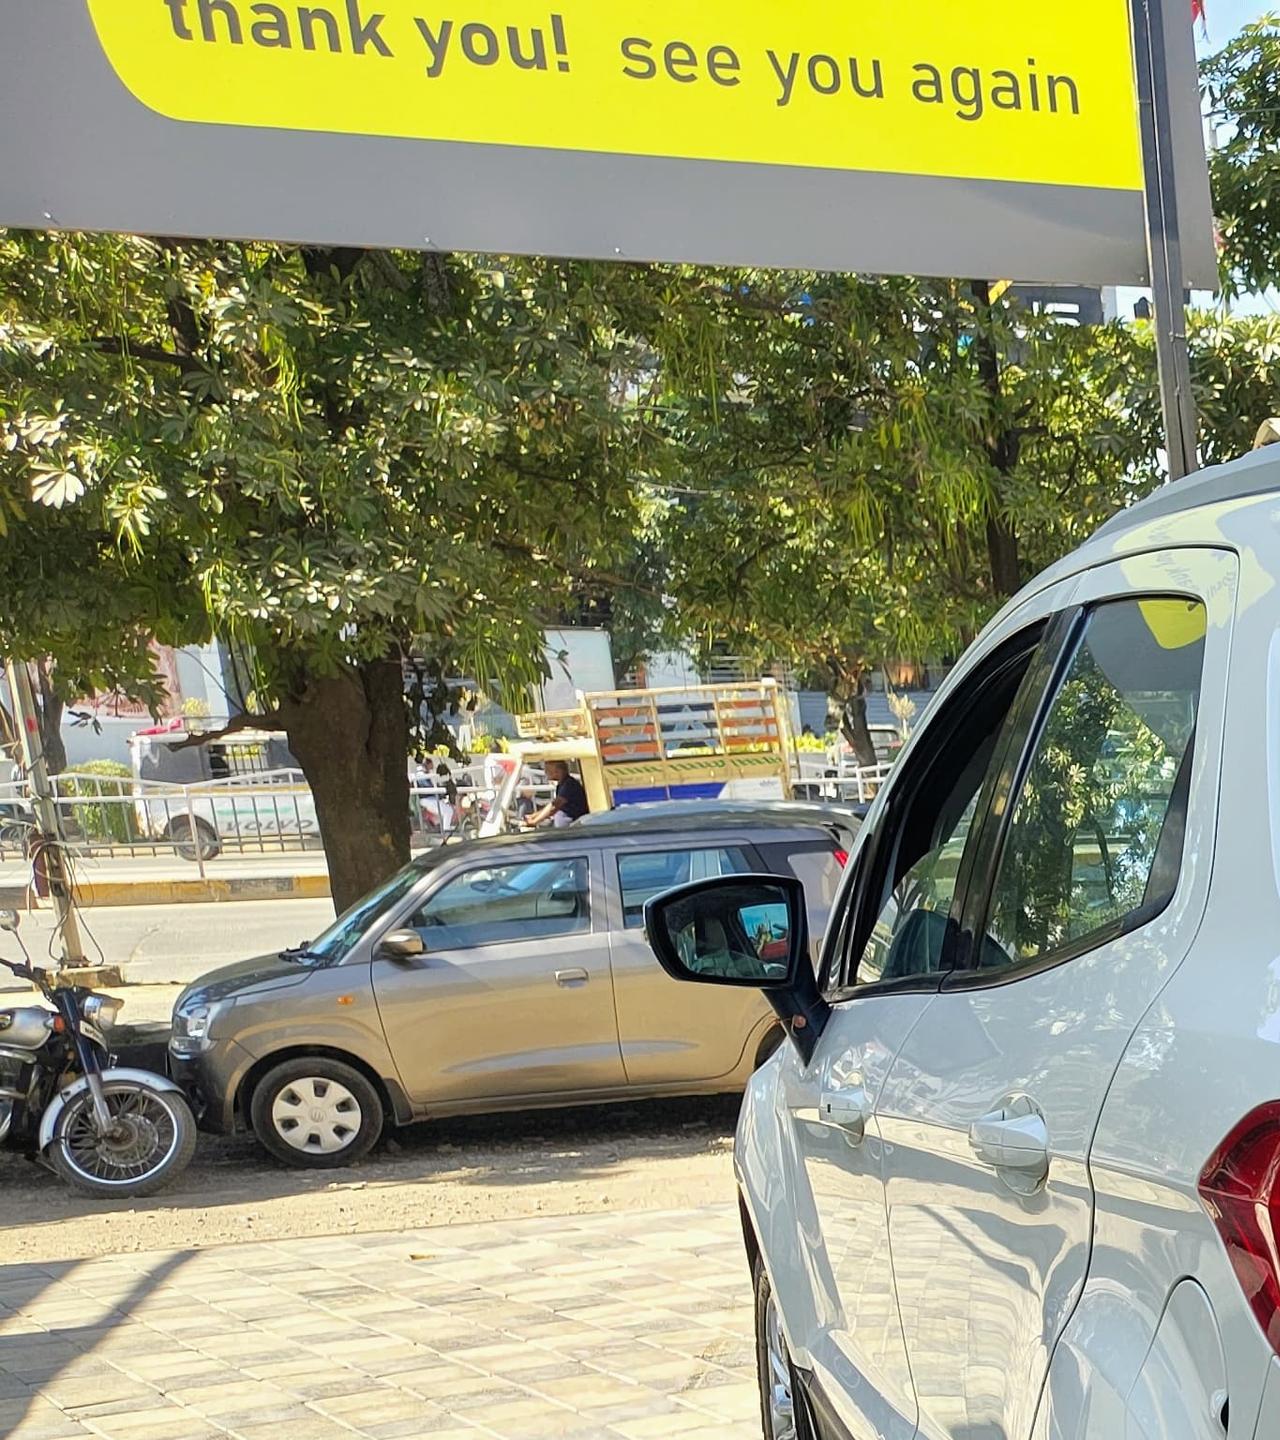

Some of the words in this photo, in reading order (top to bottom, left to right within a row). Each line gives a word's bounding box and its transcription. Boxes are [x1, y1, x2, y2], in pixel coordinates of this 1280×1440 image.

[164, 0, 395, 57] thank
[413, 14, 571, 78] you!
[619, 36, 741, 87] see
[766, 48, 885, 107] you
[911, 58, 1080, 121] again
